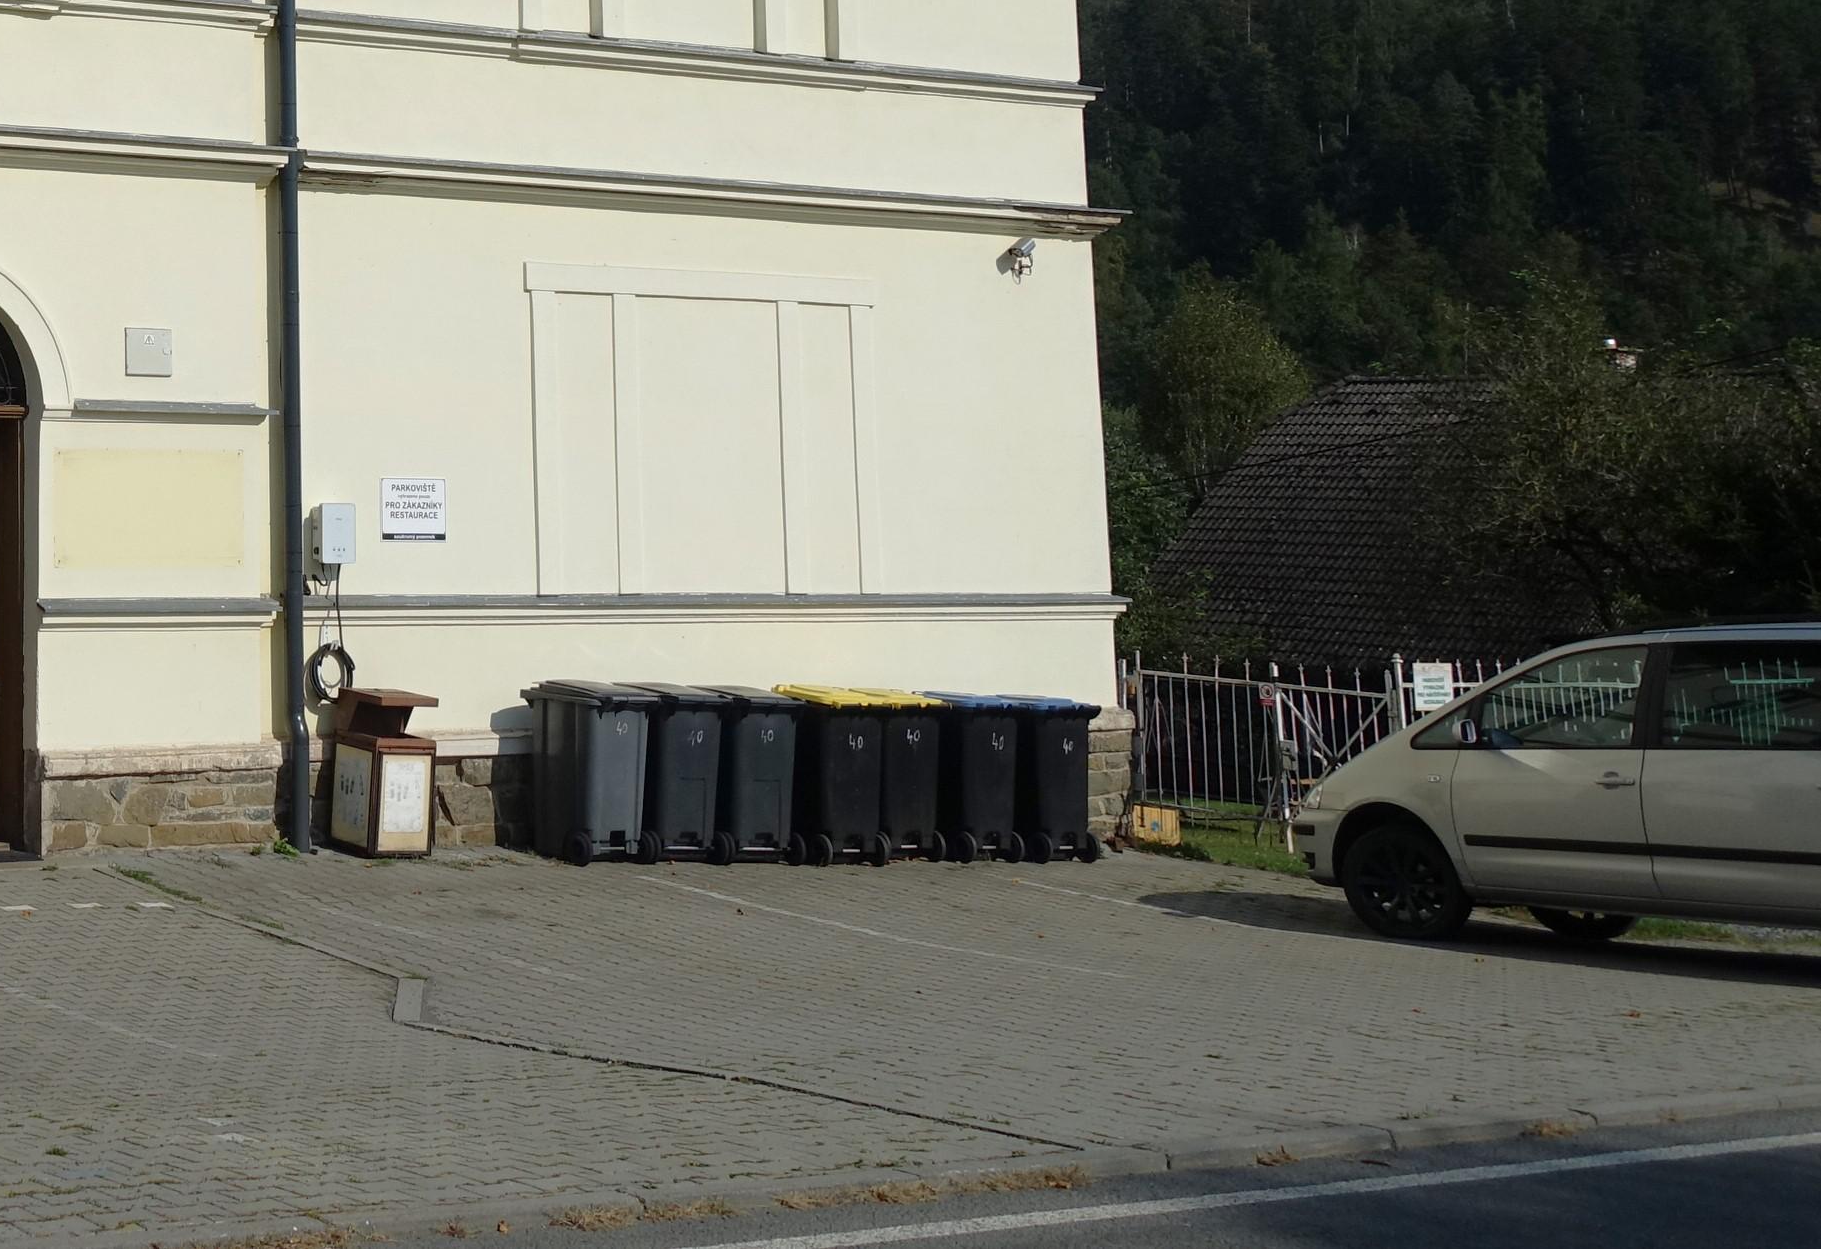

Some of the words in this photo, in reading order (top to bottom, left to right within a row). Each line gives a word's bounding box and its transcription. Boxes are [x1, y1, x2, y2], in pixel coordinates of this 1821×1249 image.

[385, 501, 401, 509] PRO
[402, 500, 442, 509] ZÁKAZNÍKY
[390, 511, 439, 519] RESTAURACE
[615, 721, 628, 735] 40
[760, 729, 775, 743] 40
[849, 734, 864, 750] 40
[906, 729, 921, 744] 40
[992, 732, 1005, 750] 40
[1063, 738, 1074, 754] 40
